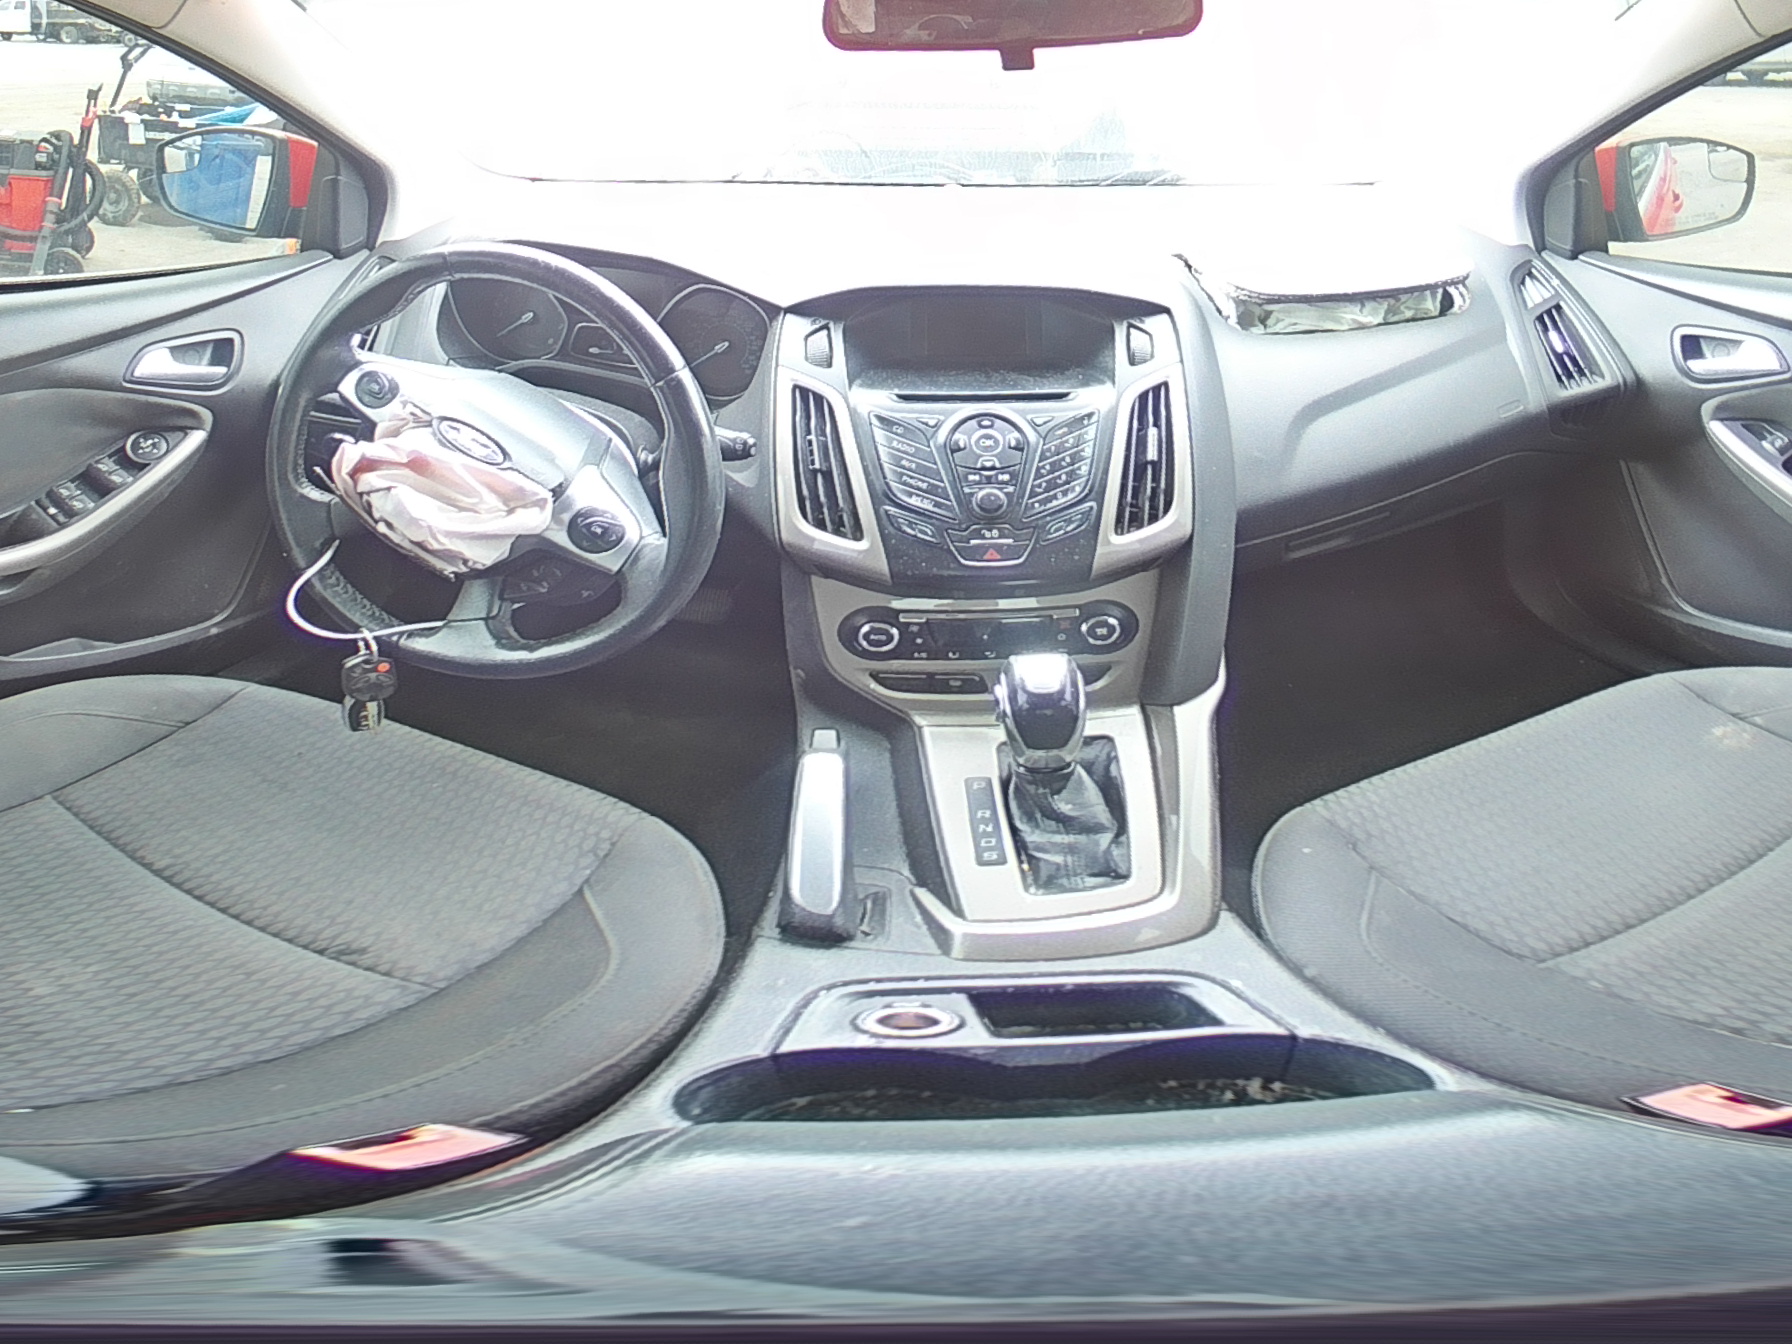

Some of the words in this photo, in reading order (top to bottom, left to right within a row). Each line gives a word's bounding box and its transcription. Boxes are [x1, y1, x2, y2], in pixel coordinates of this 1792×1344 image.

[891, 440, 915, 453] RADIO
[980, 438, 995, 446] OK
[972, 781, 986, 790] P
[976, 809, 992, 819] R
[978, 822, 994, 833] N
[980, 837, 997, 847] D
[982, 851, 999, 860] S
